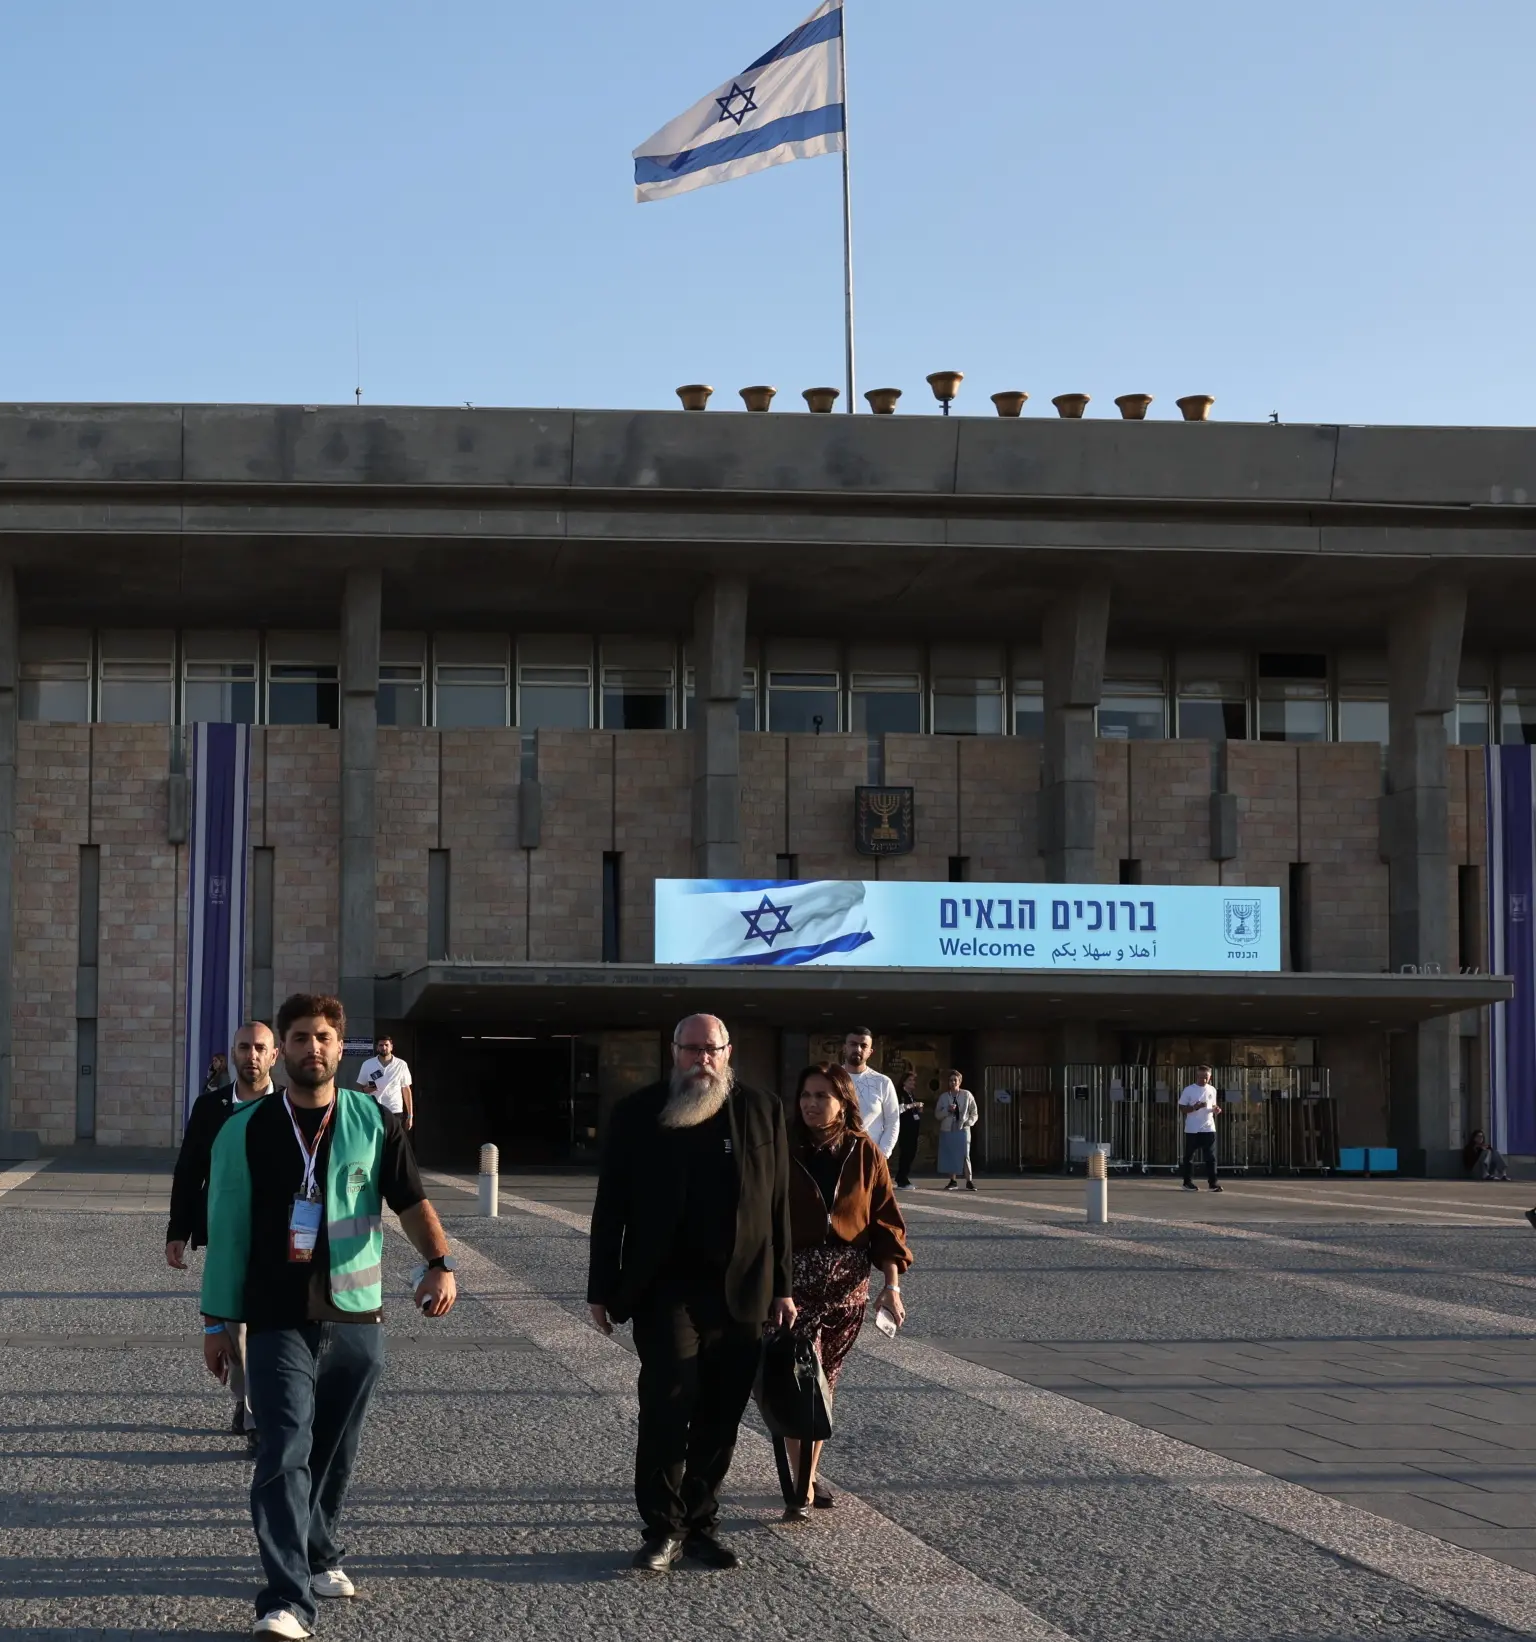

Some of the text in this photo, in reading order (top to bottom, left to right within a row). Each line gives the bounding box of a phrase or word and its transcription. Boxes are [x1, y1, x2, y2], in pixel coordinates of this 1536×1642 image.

[940, 898, 1157, 931] ברוכים הבאים
[939, 937, 1036, 957] Welcome
[1051, 939, 1157, 964] أهلا و سهلا بكم
[1227, 951, 1258, 959] הכנסת
